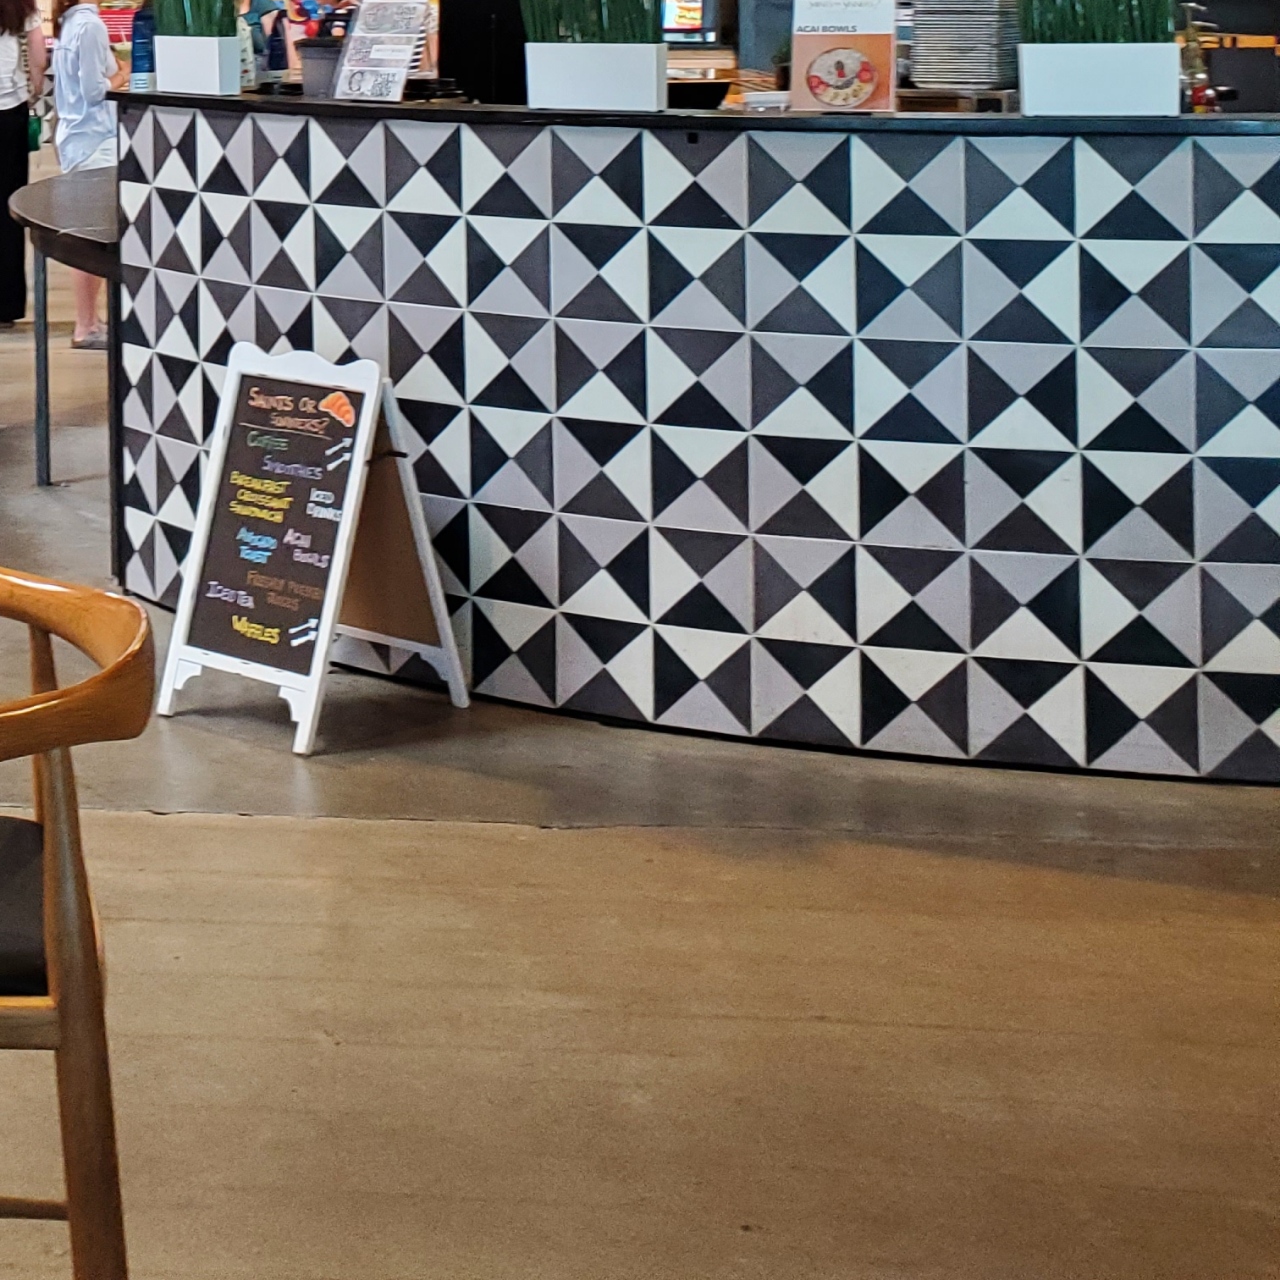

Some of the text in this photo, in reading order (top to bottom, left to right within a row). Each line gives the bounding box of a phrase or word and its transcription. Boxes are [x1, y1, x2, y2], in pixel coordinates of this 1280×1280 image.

[796, 25, 858, 33] ACAI BOWLS
[247, 387, 318, 414] SAINTS OR
[309, 487, 335, 504] ICED
